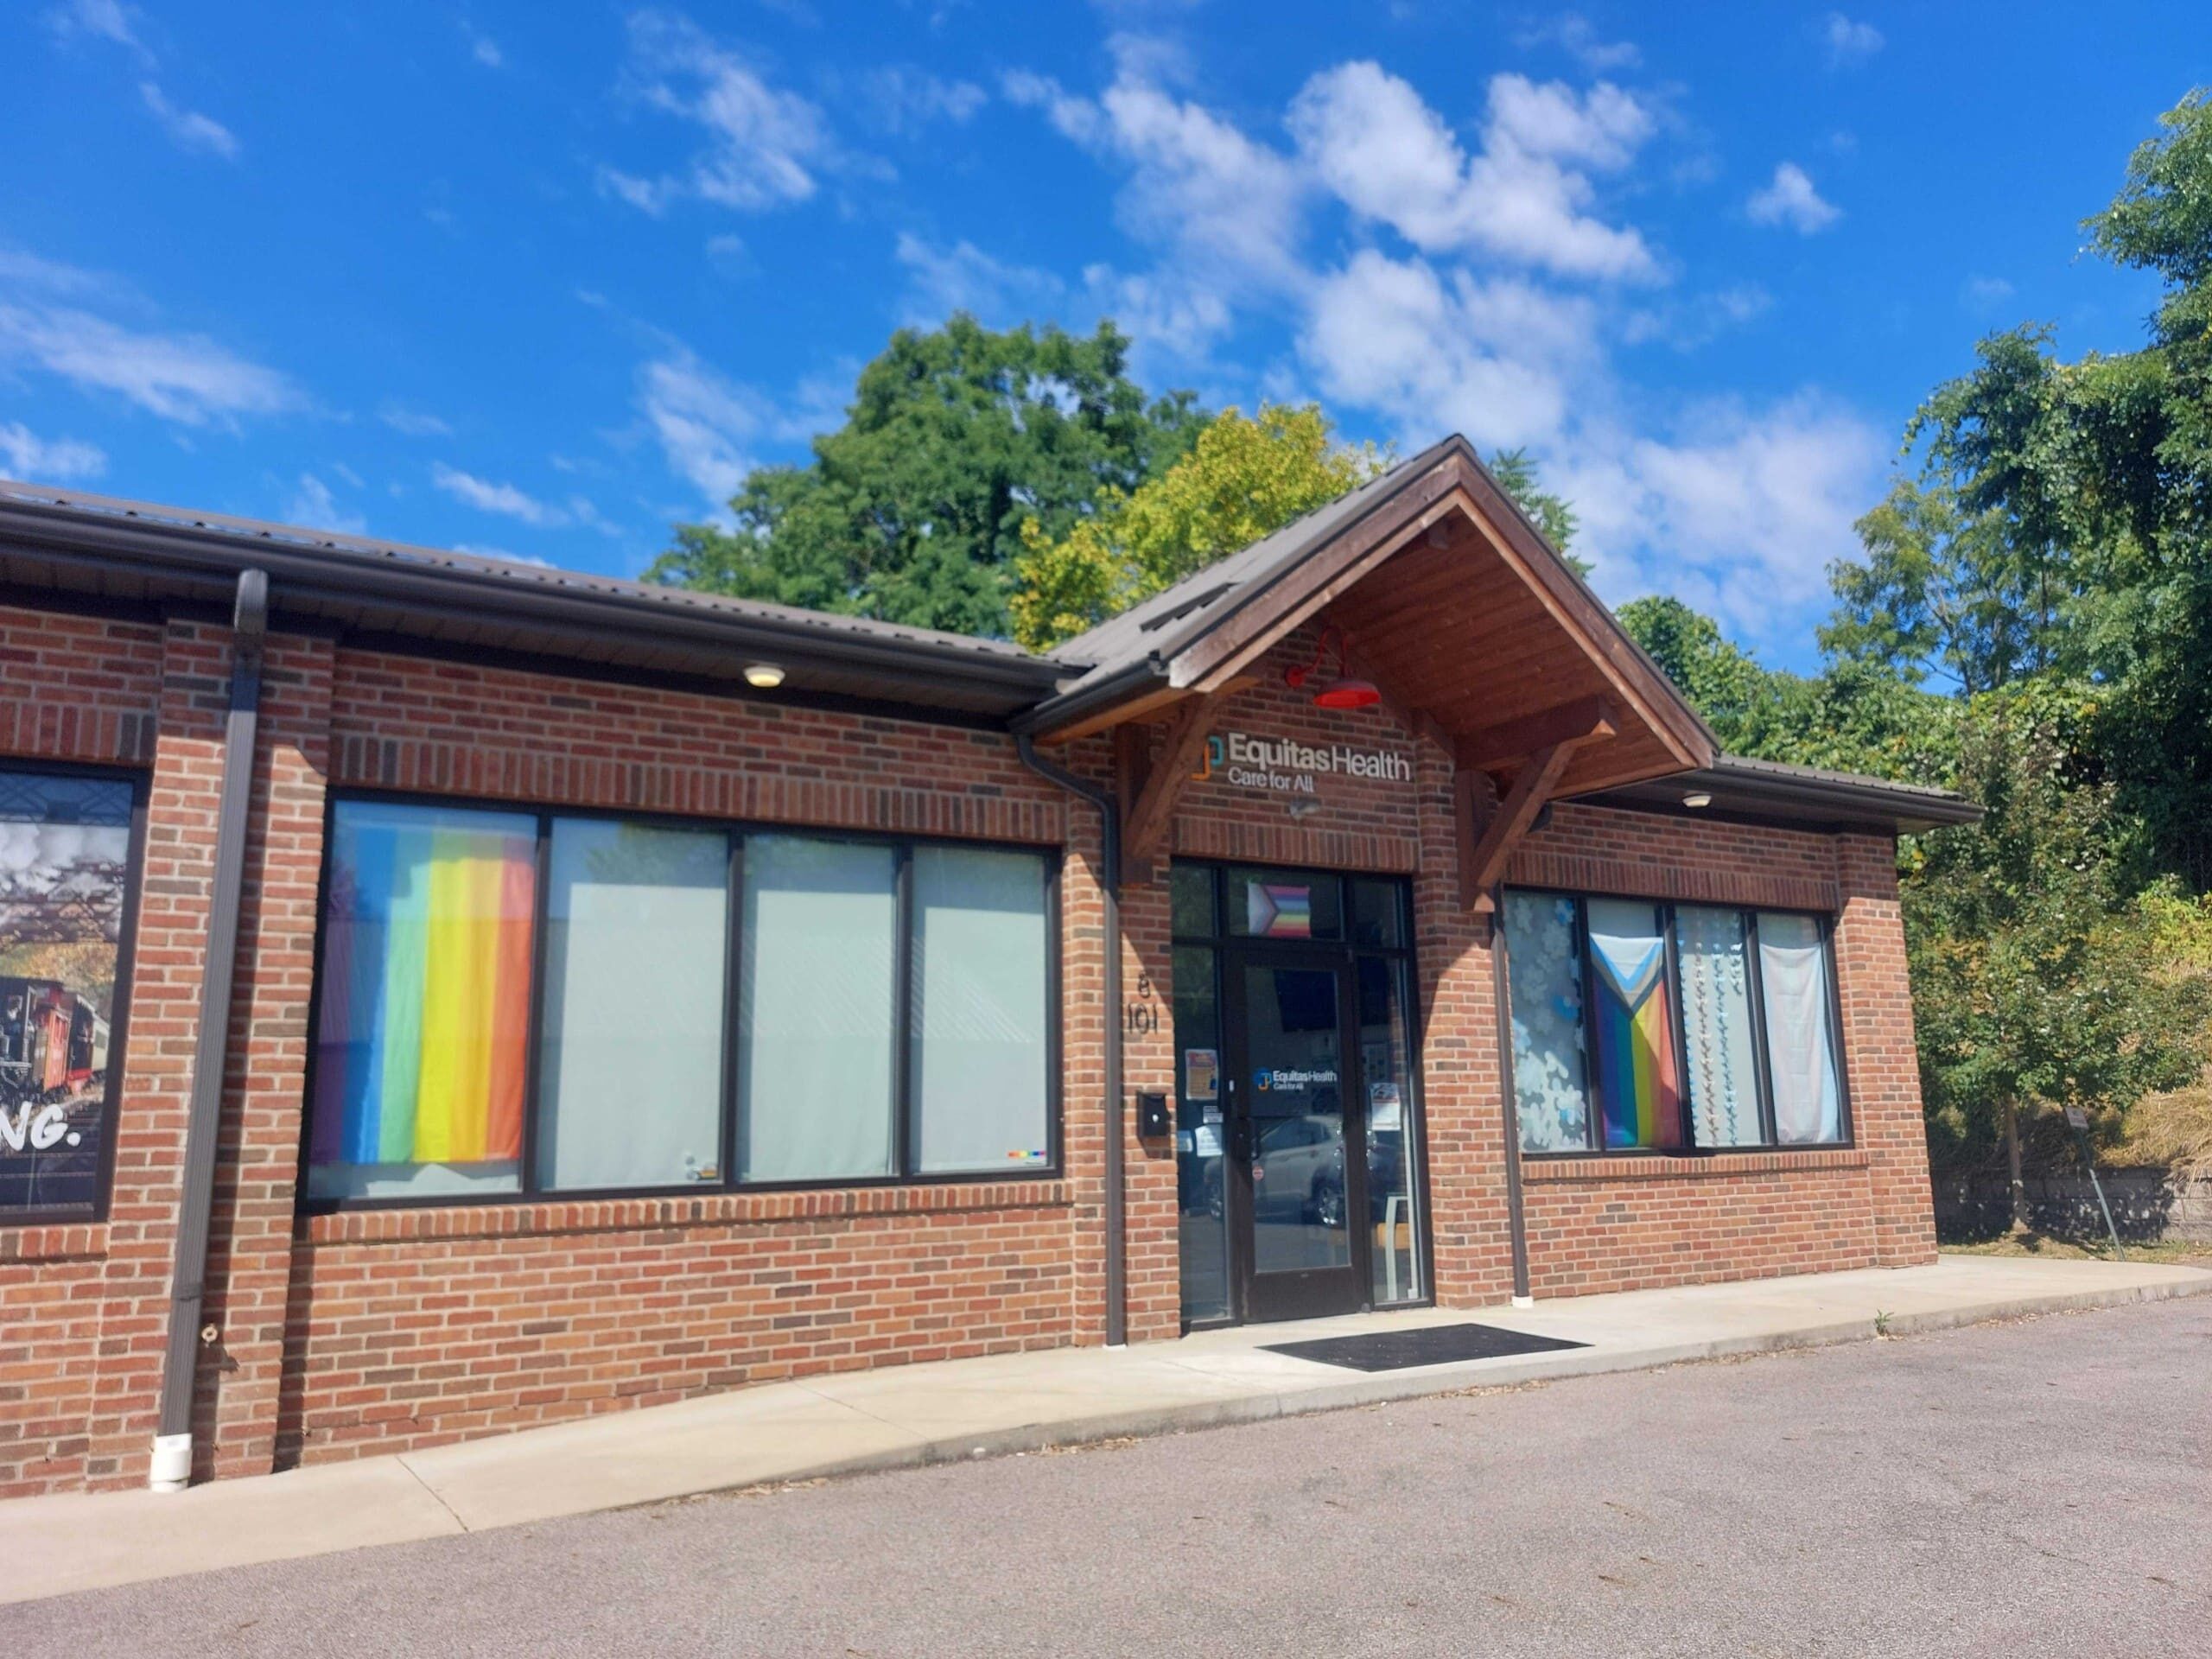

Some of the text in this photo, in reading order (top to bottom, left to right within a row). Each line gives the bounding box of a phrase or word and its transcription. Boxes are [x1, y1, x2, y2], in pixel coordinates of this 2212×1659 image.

[1228, 766, 1314, 792] Care for All
[1128, 1002, 1158, 1034] 101
